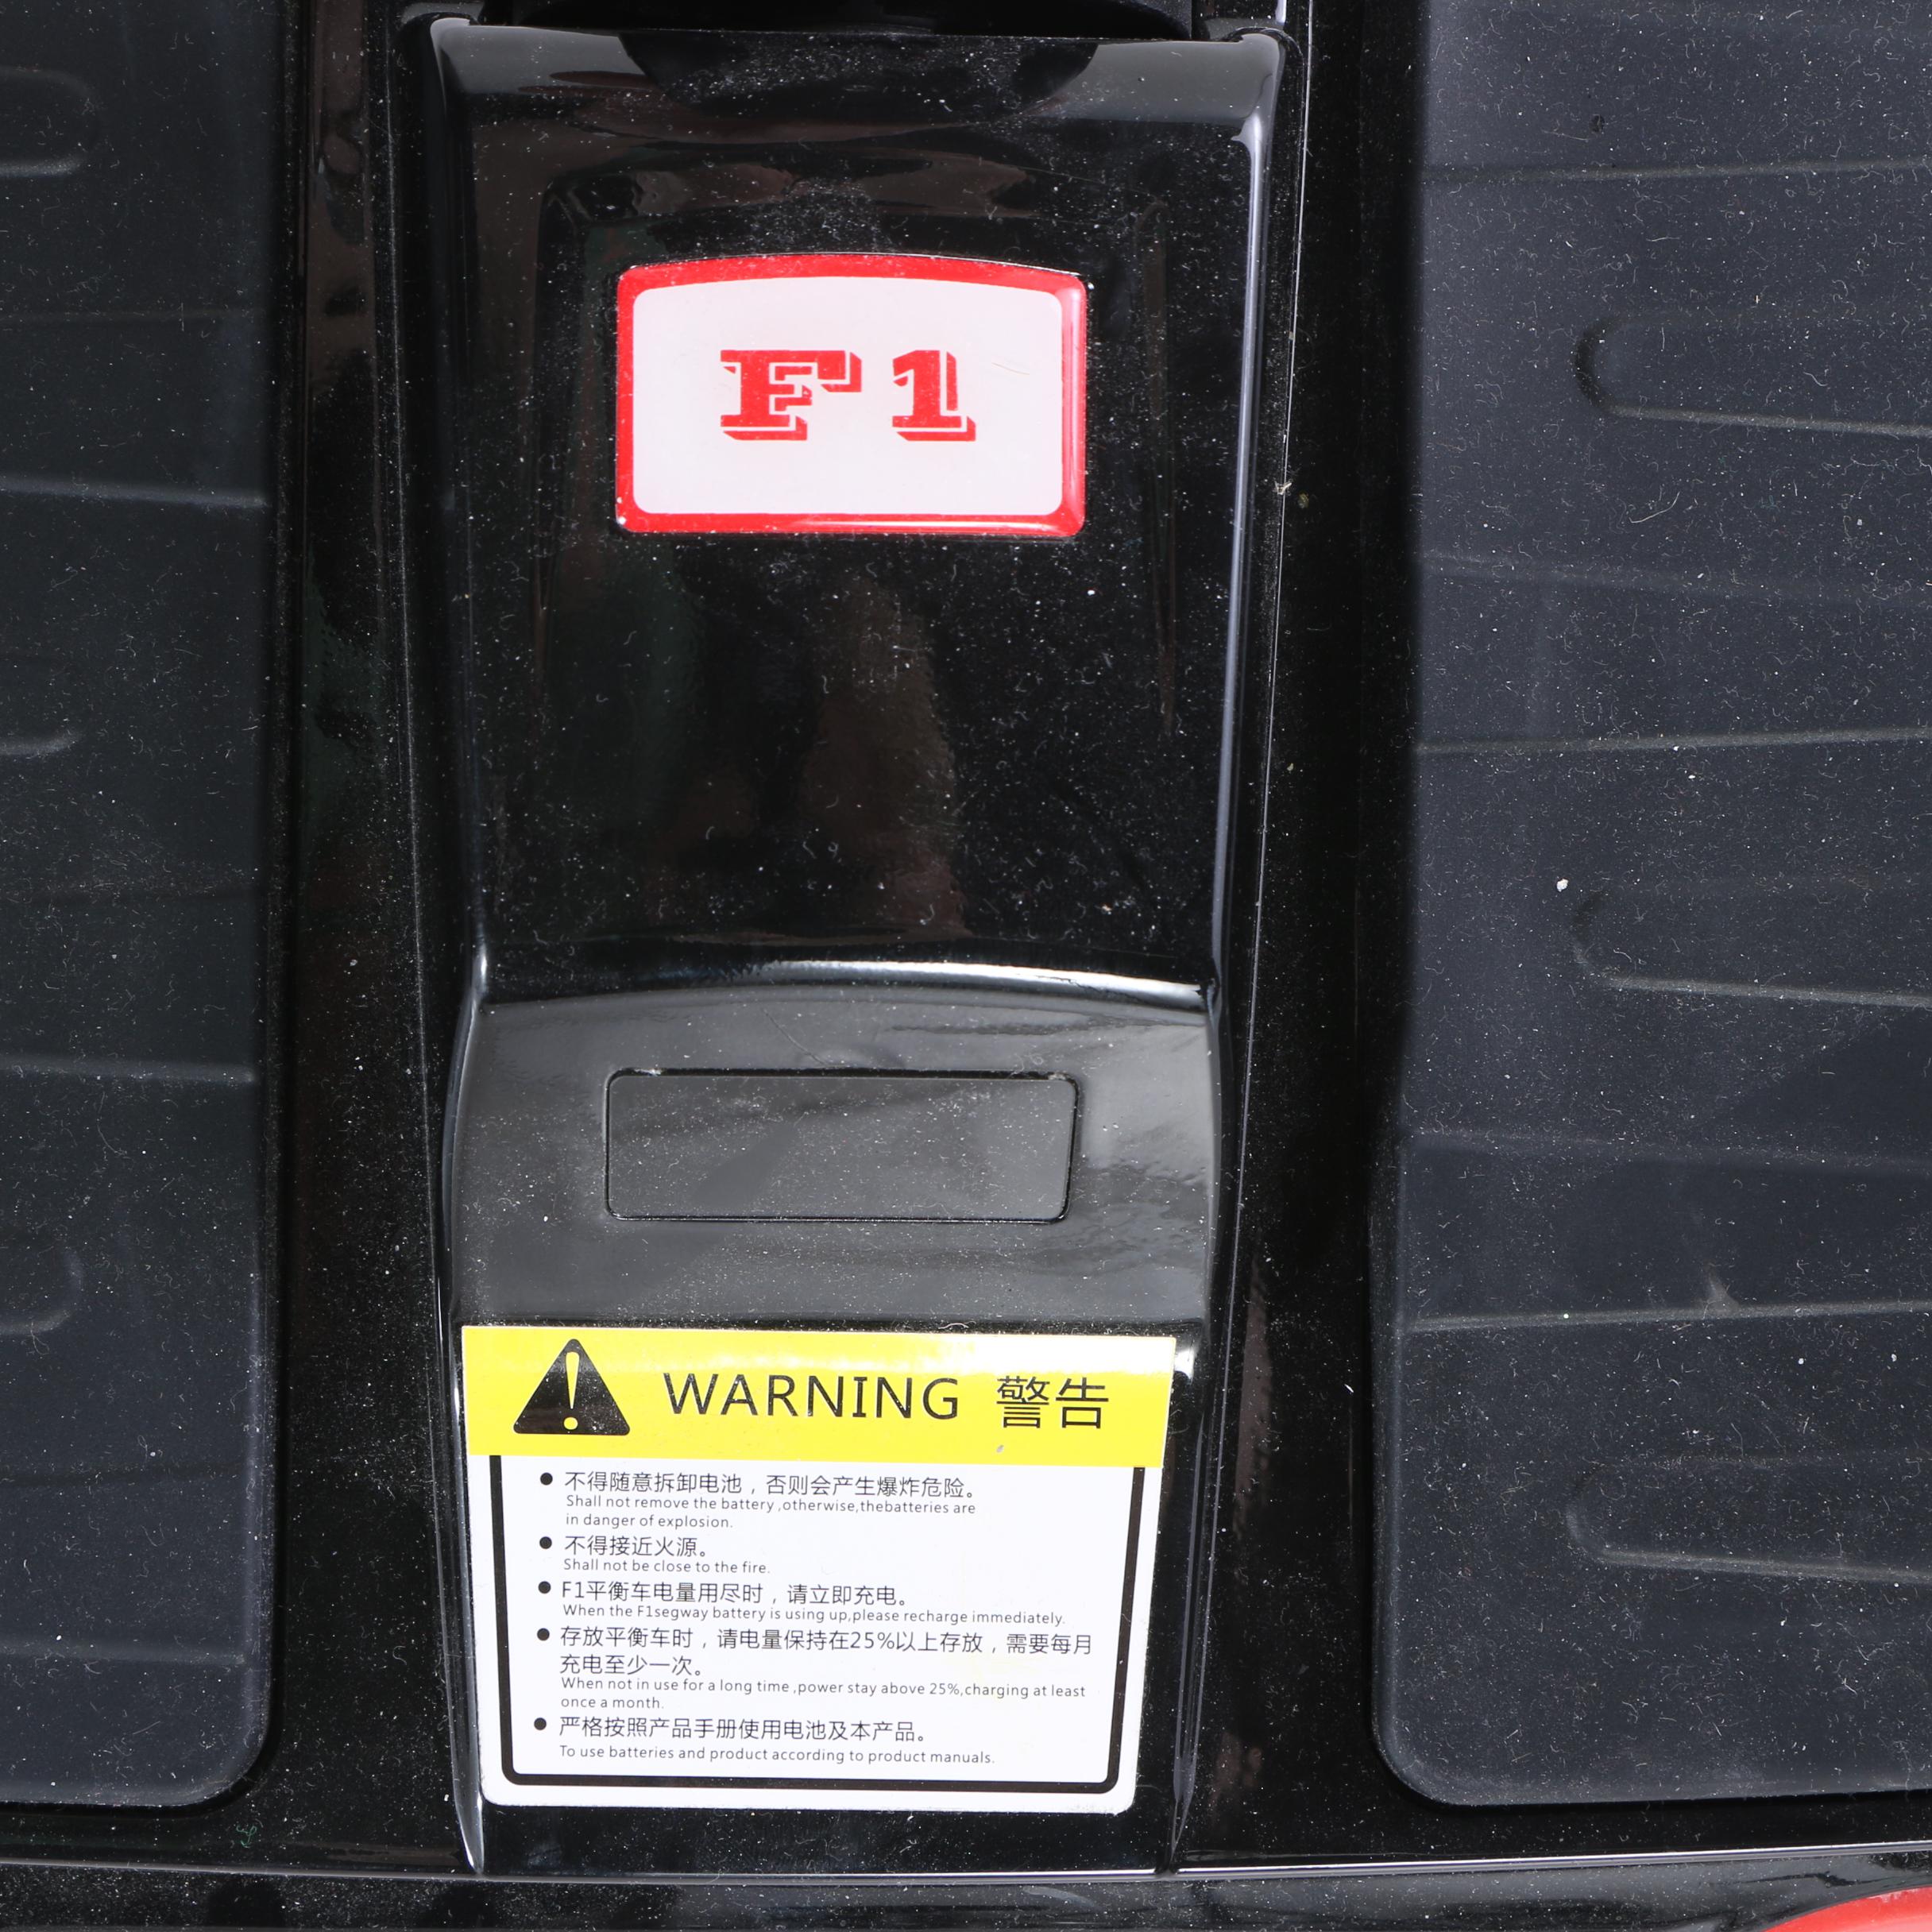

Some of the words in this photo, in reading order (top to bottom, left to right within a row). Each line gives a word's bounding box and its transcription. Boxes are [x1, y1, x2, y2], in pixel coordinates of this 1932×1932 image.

[720, 349, 977, 442] F1
[663, 1373, 958, 1420] WARNING
[995, 1375, 1109, 1429] 警告
[566, 1493, 601, 1507] Shall
[606, 1496, 630, 1508] not
[635, 1498, 690, 1509] remove
[693, 1496, 717, 1509] the
[721, 1496, 775, 1513] battery
[952, 1504, 976, 1514] are
[566, 1513, 579, 1524] in
[583, 1512, 636, 1529] danger
[639, 1513, 655, 1527] of
[658, 1514, 733, 1530] explosion.
[564, 1533, 705, 1558] 不得接近火源。
[563, 1557, 599, 1571] Shall
[603, 1559, 628, 1571] not
[632, 1558, 650, 1572] be
[653, 1559, 692, 1572] close
[695, 1561, 710, 1573] to
[714, 1559, 738, 1573] the
[742, 1560, 770, 1574] fire.
[562, 1603, 605, 1617] When
[609, 1603, 633, 1617] the
[637, 1604, 709, 1621] F1segway
[713, 1605, 766, 1622] battery
[770, 1606, 781, 1619] is
[785, 1607, 825, 1623] using
[903, 1609, 968, 1625] recharge
[972, 1610, 1066, 1627] immediately.
[559, 1652, 701, 1676] 充电至少一次。
[561, 1675, 603, 1689] When
[608, 1678, 632, 1690] not
[636, 1677, 650, 1690] in
[654, 1680, 679, 1690] use
[682, 1677, 704, 1691] for
[708, 1681, 716, 1691] a
[720, 1678, 752, 1695] long
[756, 1679, 790, 1693] time
[847, 1682, 877, 1697] stay
[880, 1681, 925, 1694] above
[1033, 1685, 1047, 1696] at
[1051, 1683, 1086, 1697] least
[561, 1698, 597, 1707] once
[600, 1698, 608, 1709] a
[612, 1696, 664, 1709] month.
[558, 1714, 924, 1742] 严格按照产品手册使用电池及本产品。
[559, 1745, 576, 1757] To
[580, 1747, 605, 1758] use
[609, 1745, 674, 1759] batteries
[678, 1746, 705, 1760] and
[709, 1747, 768, 1762] product
[771, 1748, 844, 1764] according
[849, 1750, 864, 1761] to
[868, 1749, 926, 1764] product
[930, 1750, 995, 1764] manuals.
